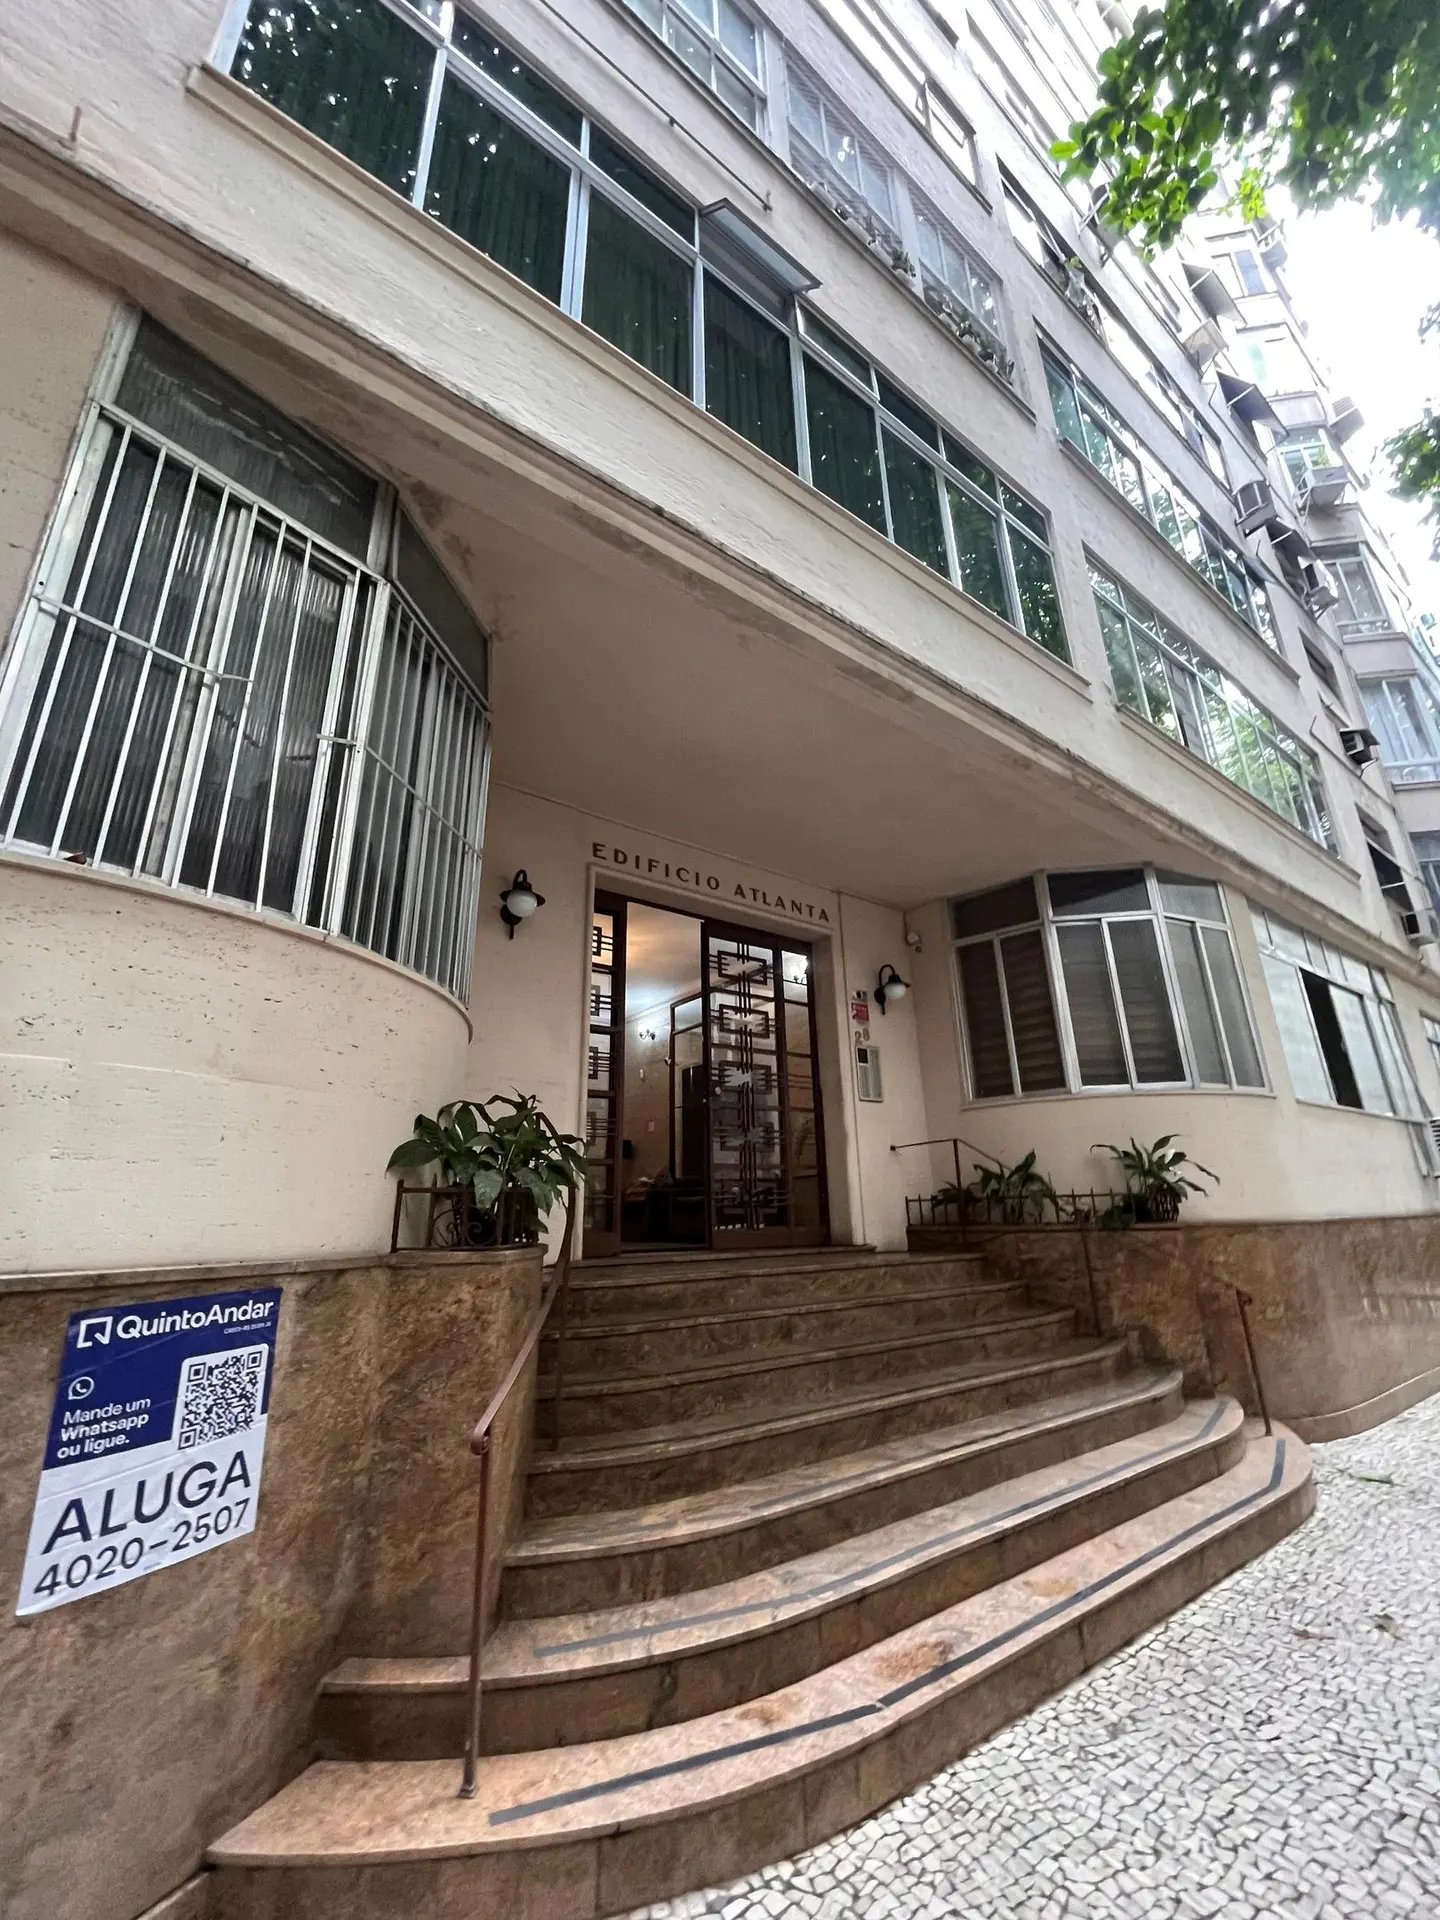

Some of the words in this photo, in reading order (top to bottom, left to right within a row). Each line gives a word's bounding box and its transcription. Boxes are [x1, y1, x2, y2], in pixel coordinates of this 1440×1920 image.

[592, 842, 720, 891] EDIFICIO
[734, 883, 830, 923] ATLANTA
[117, 1299, 274, 1340] QuintoAndar
[61, 1413, 149, 1441] Whatsapp
[63, 1402, 123, 1425] Mande
[126, 1398, 151, 1412] um
[57, 1445, 81, 1459] ou
[84, 1434, 130, 1454] ligue.
[40, 1450, 251, 1556] ALUGA
[33, 1498, 250, 1597] 4020-2507
